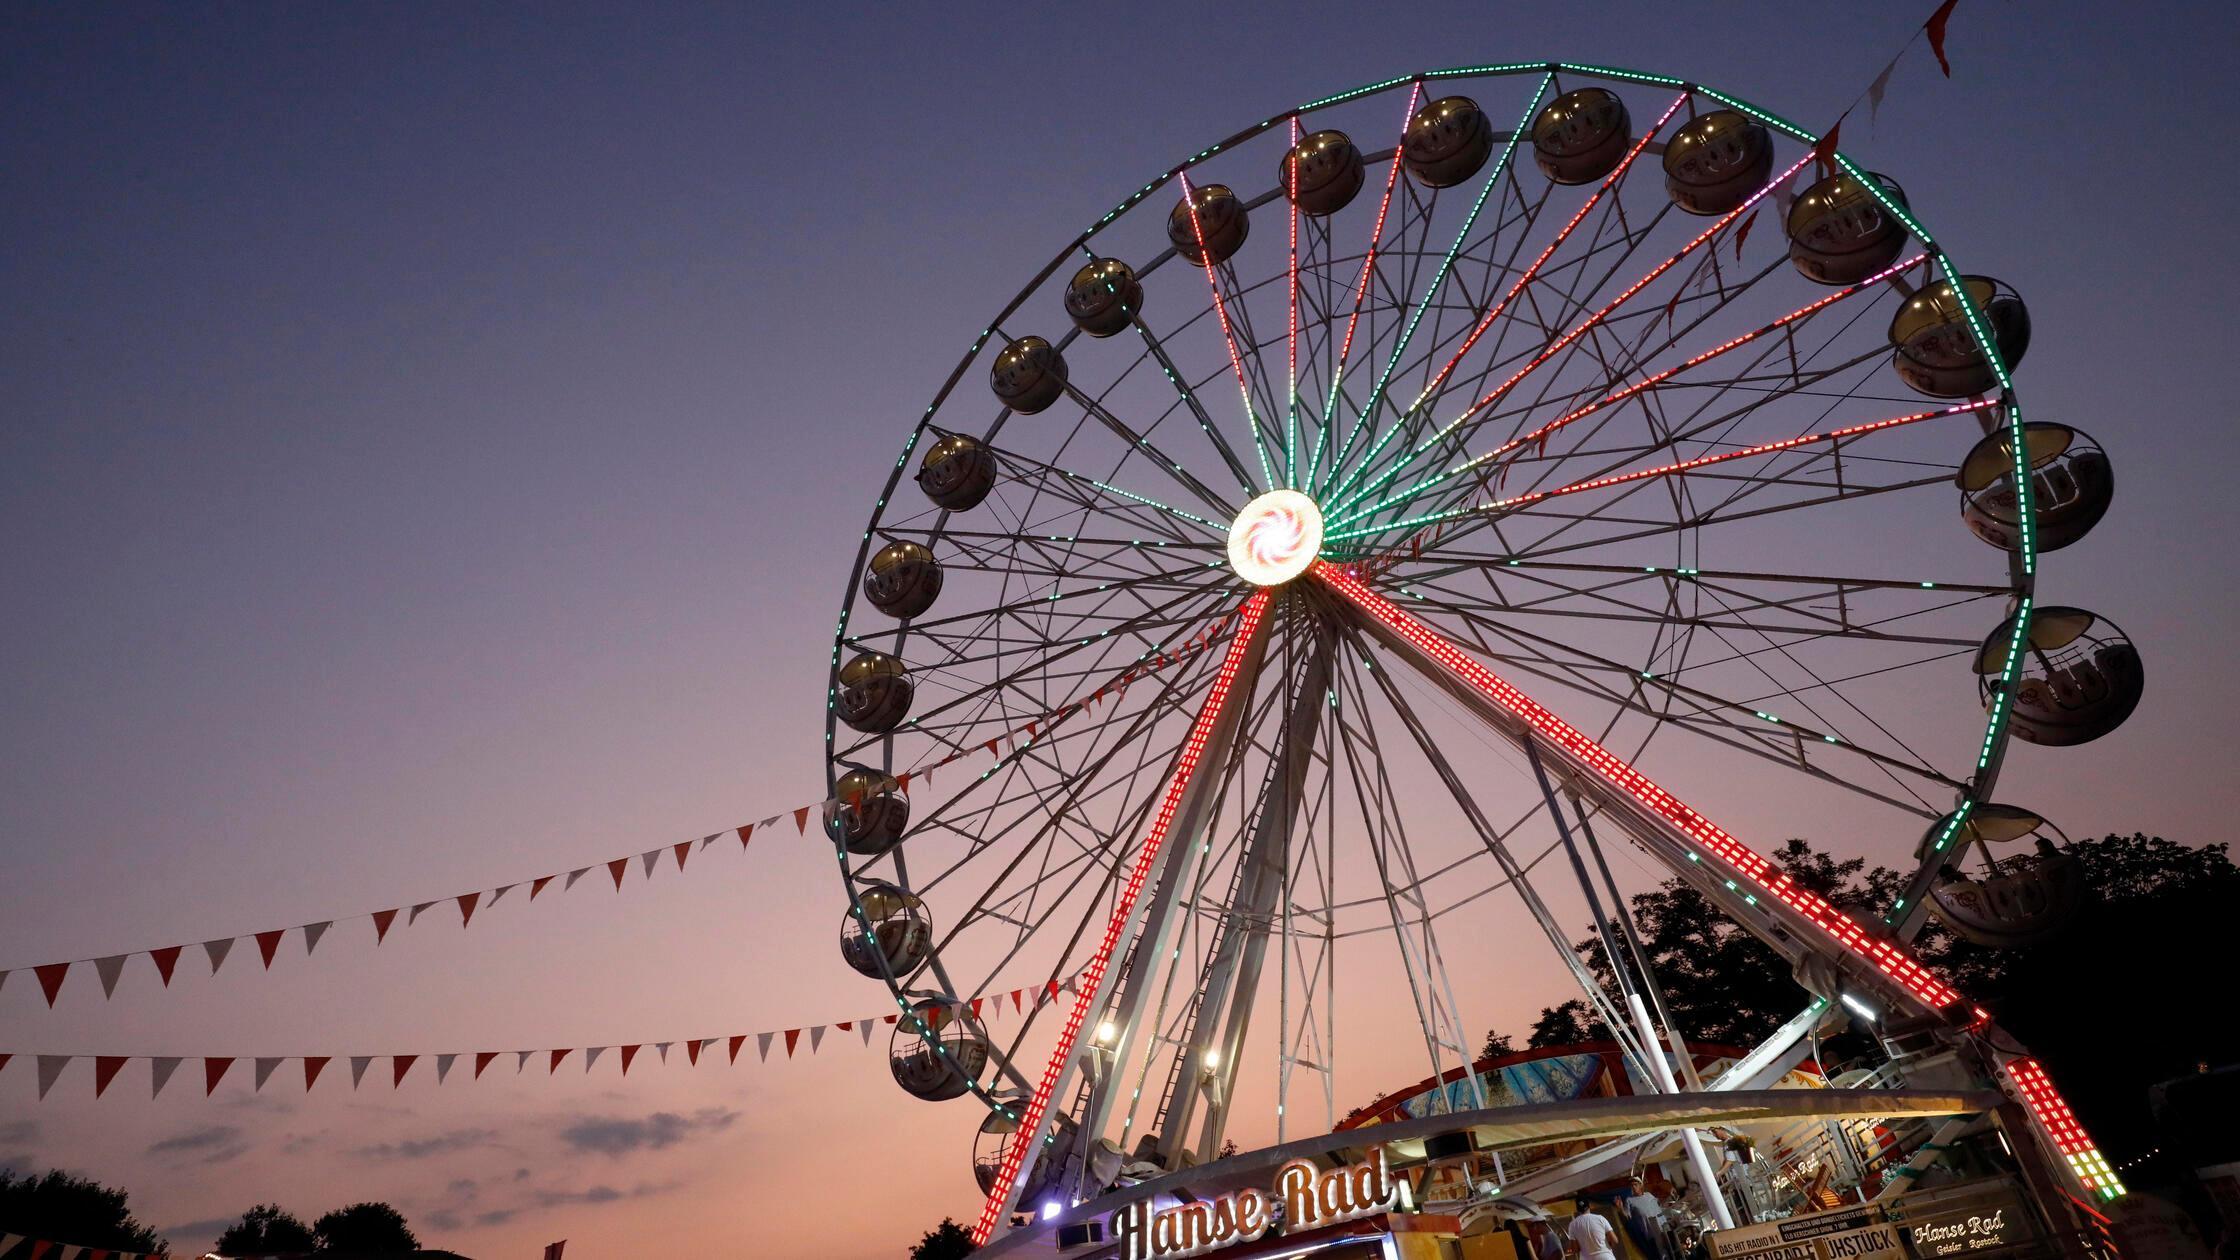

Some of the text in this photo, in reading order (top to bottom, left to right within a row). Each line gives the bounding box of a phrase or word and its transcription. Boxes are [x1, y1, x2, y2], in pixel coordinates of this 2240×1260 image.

[1110, 1147, 1398, 1260] Hanse Rad
[1914, 1209, 2005, 1244] Hanse Rad
[1718, 1244, 1733, 1255] DAS
[1734, 1241, 1746, 1252] HIT
[1747, 1236, 1768, 1249] RADIO
[1936, 1234, 2004, 1256] Geisler Rostock
